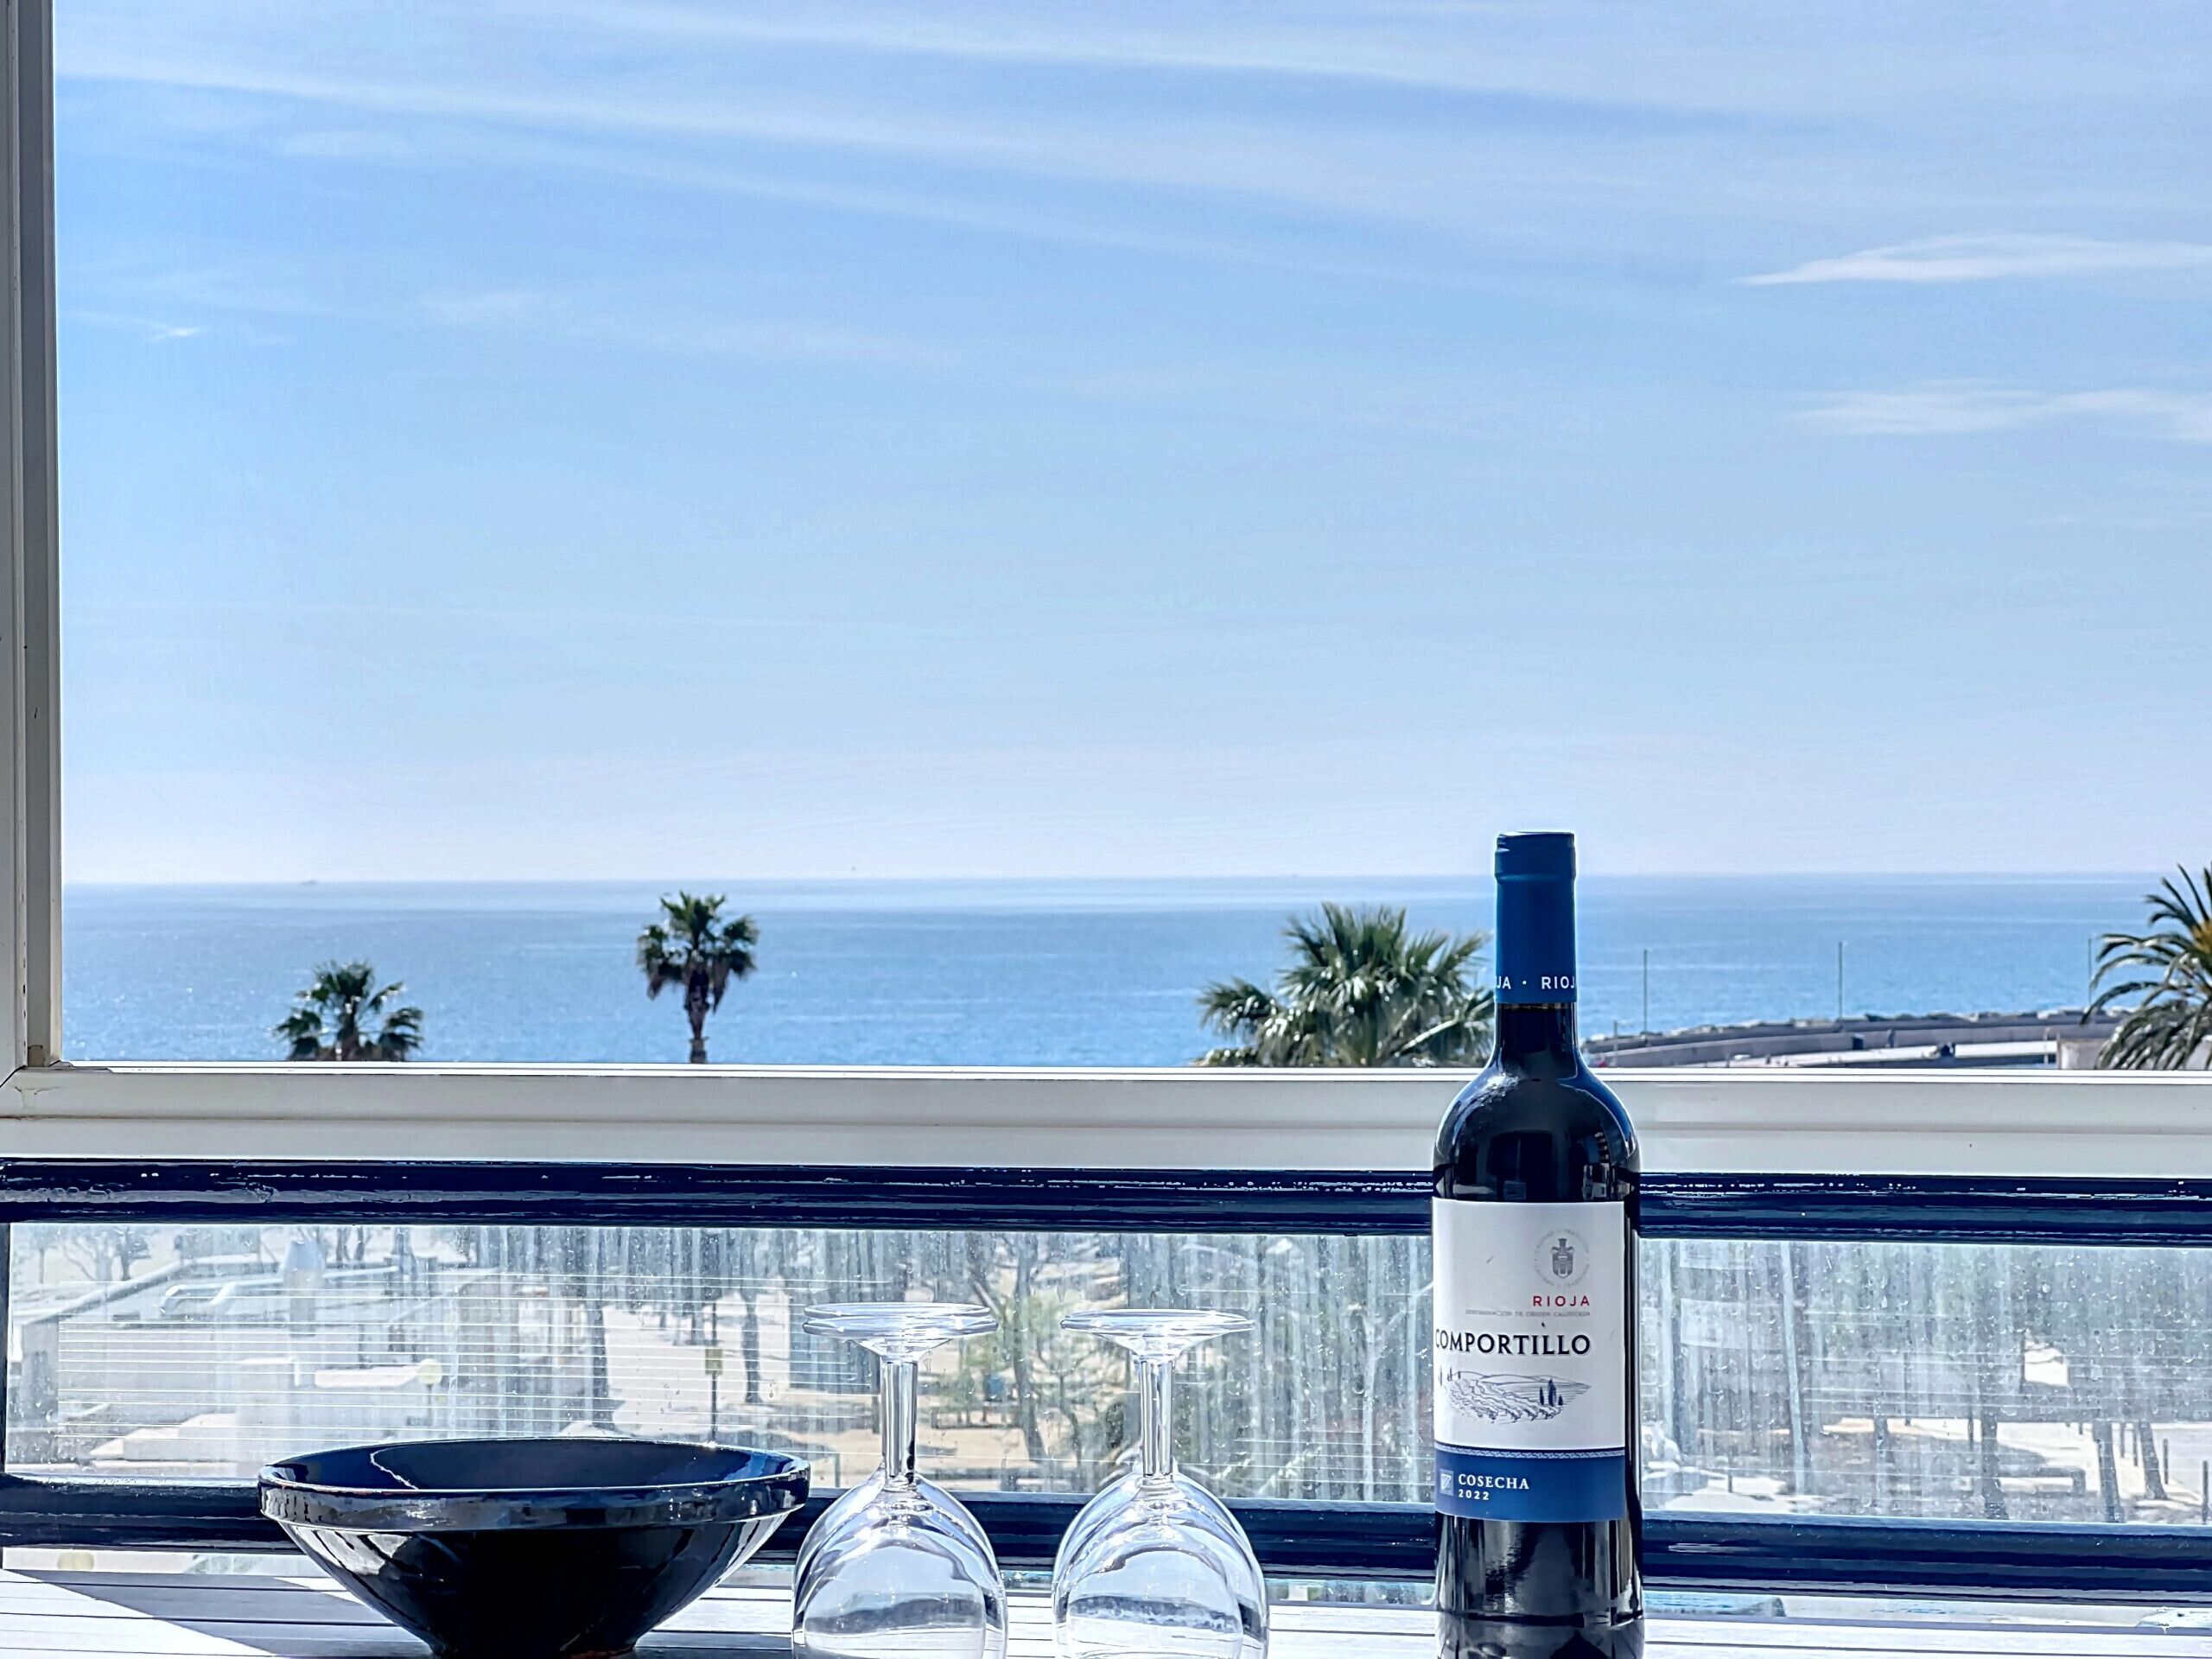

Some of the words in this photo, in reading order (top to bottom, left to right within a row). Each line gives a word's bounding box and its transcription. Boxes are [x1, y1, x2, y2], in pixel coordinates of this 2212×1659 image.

[1533, 1295, 1590, 1306] RIOJA
[1435, 1328, 1591, 1356] COMPORTILLO
[1458, 1473, 1530, 1490] COSECHA
[1458, 1488, 1490, 1501] 2022
